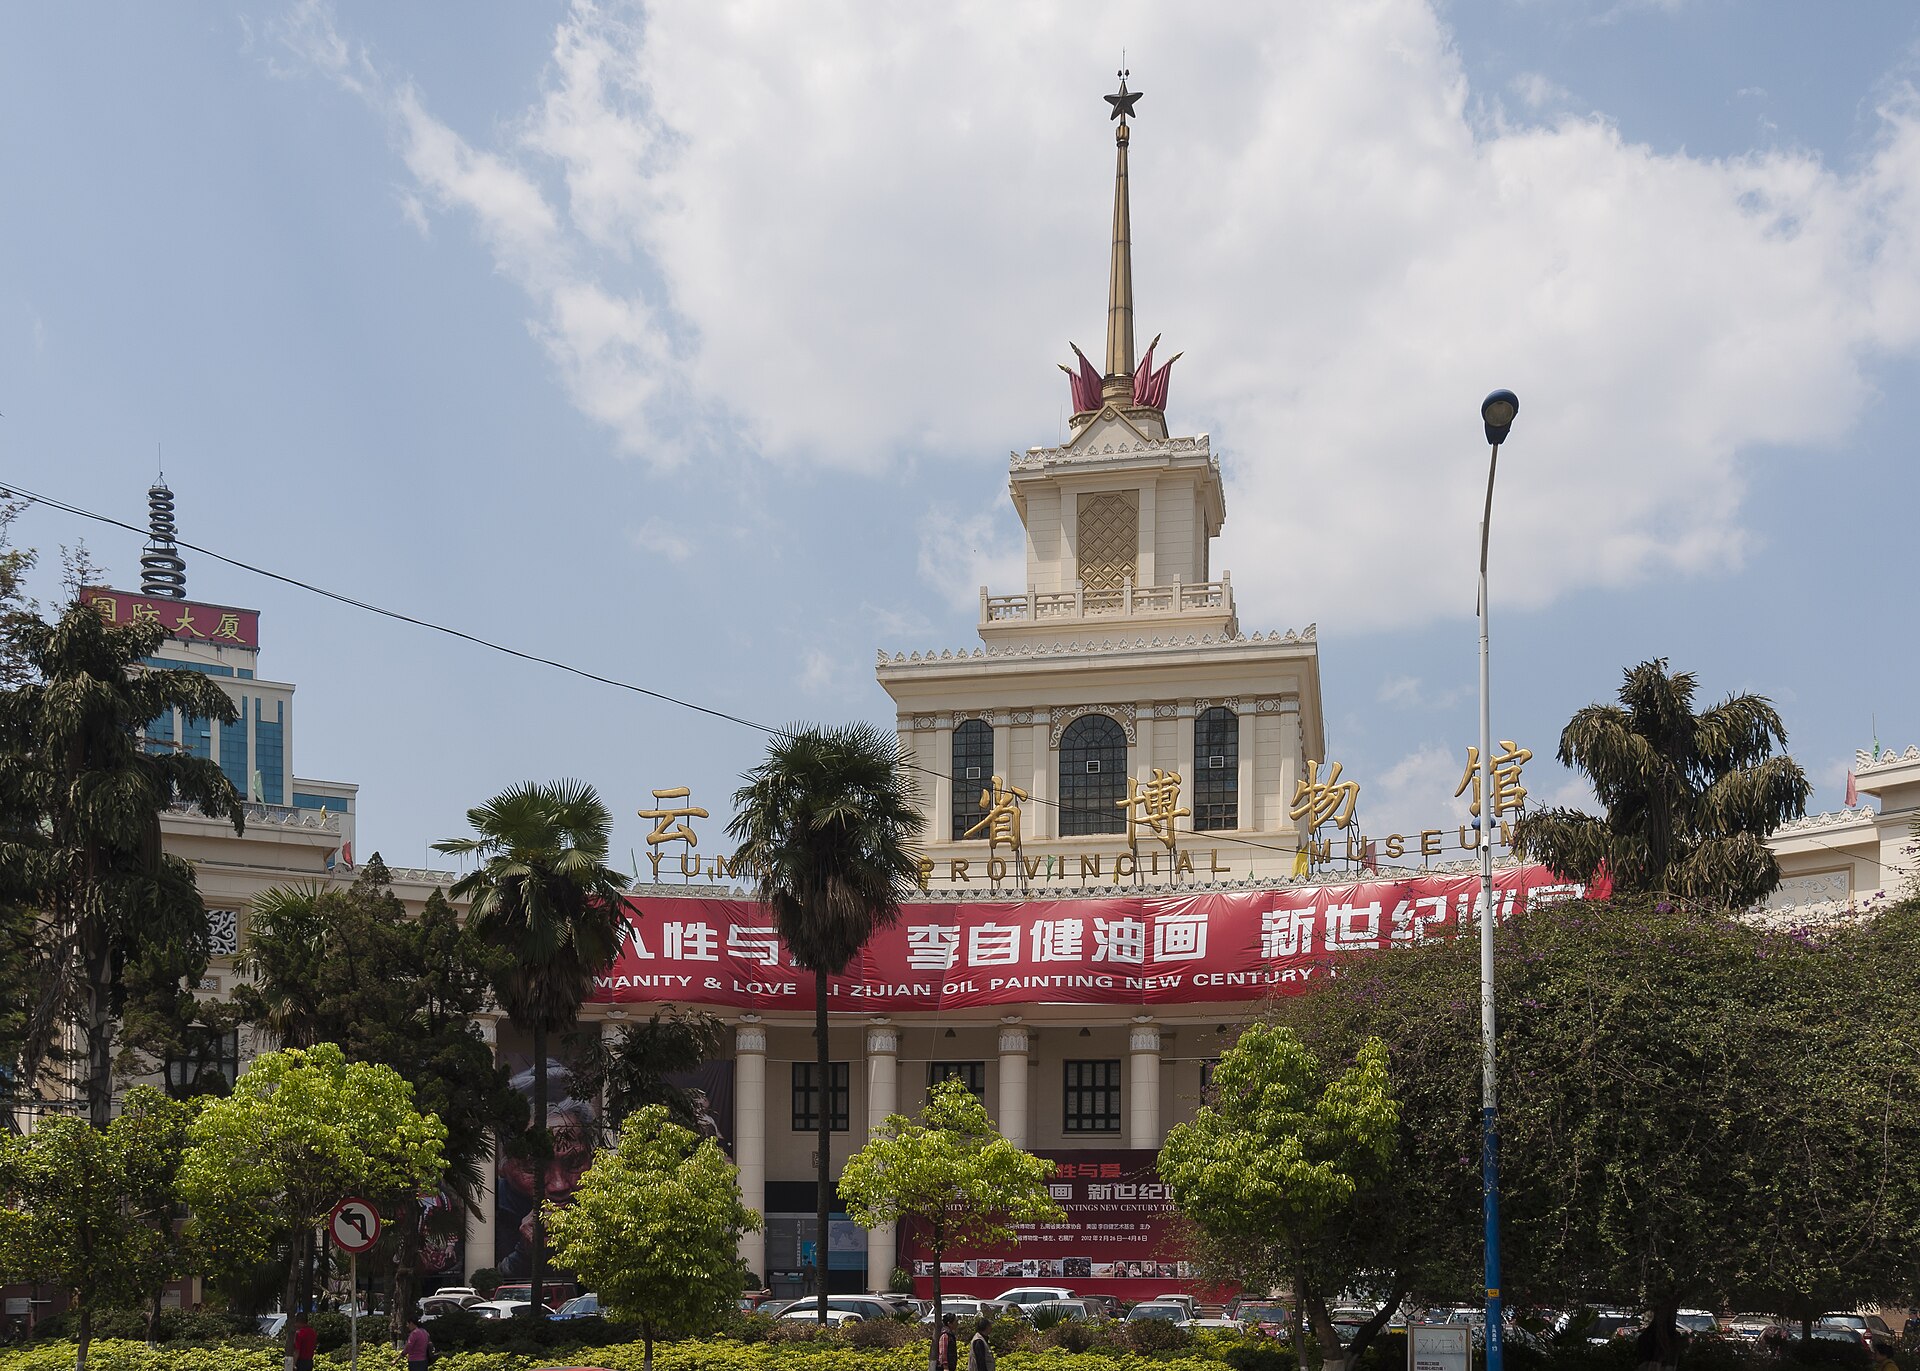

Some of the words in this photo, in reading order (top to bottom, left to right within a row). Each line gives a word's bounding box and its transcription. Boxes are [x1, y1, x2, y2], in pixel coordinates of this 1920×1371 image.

[638, 741, 1533, 850] 云省博物馆
[919, 849, 1231, 883] PROVINCIAL
[613, 917, 806, 967] 人性与
[907, 914, 1209, 970] 李自健油画
[593, 975, 692, 988] MANITY
[703, 977, 722, 990] &
[733, 979, 797, 995] LOVE
[850, 983, 931, 997] ZIJIAN
[942, 980, 980, 995] OIL
[990, 974, 1113, 990] PAINTING
[1125, 975, 1182, 990] NEW
[1192, 967, 1317, 986] CENTURY
[1048, 1163, 1121, 1179] 性与爱
